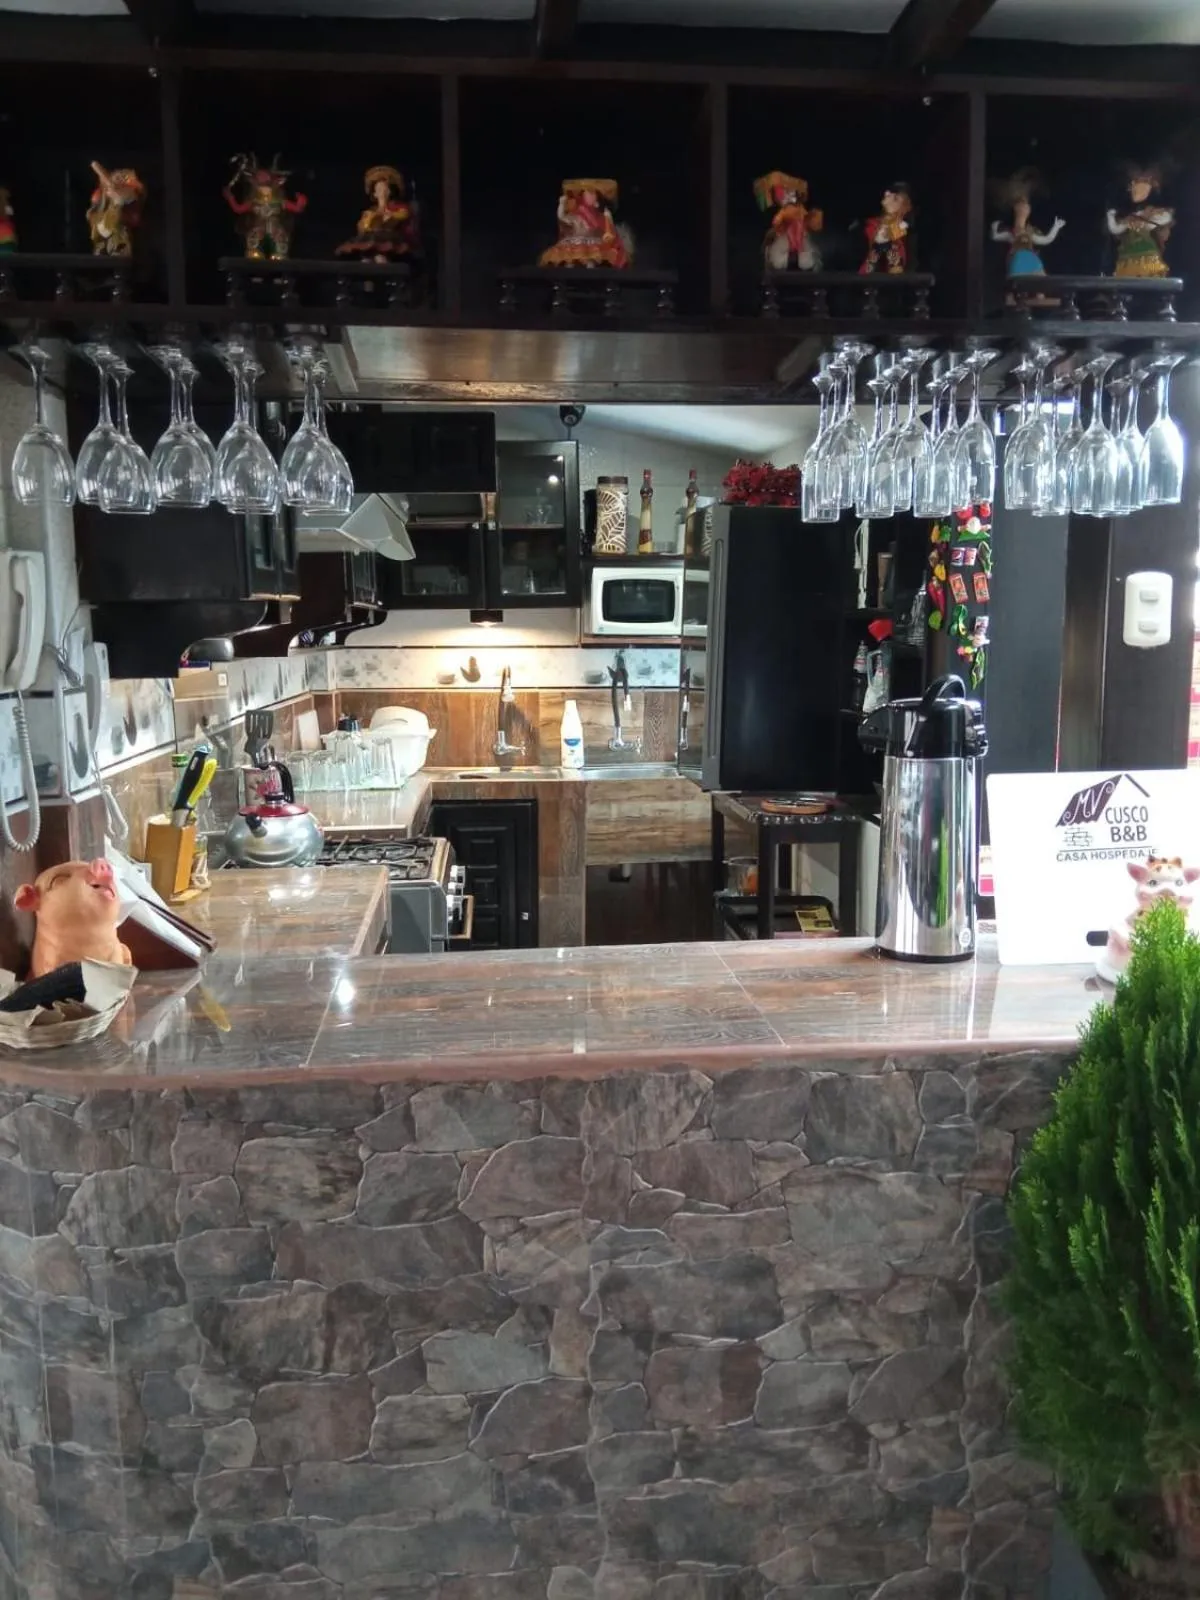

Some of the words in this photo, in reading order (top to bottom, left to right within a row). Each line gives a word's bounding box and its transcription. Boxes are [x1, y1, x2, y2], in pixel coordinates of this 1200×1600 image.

[1063, 780, 1115, 825] MV
[1105, 806, 1149, 824] CUSCO
[1110, 826, 1147, 842] B&B
[1056, 851, 1088, 862] CASA
